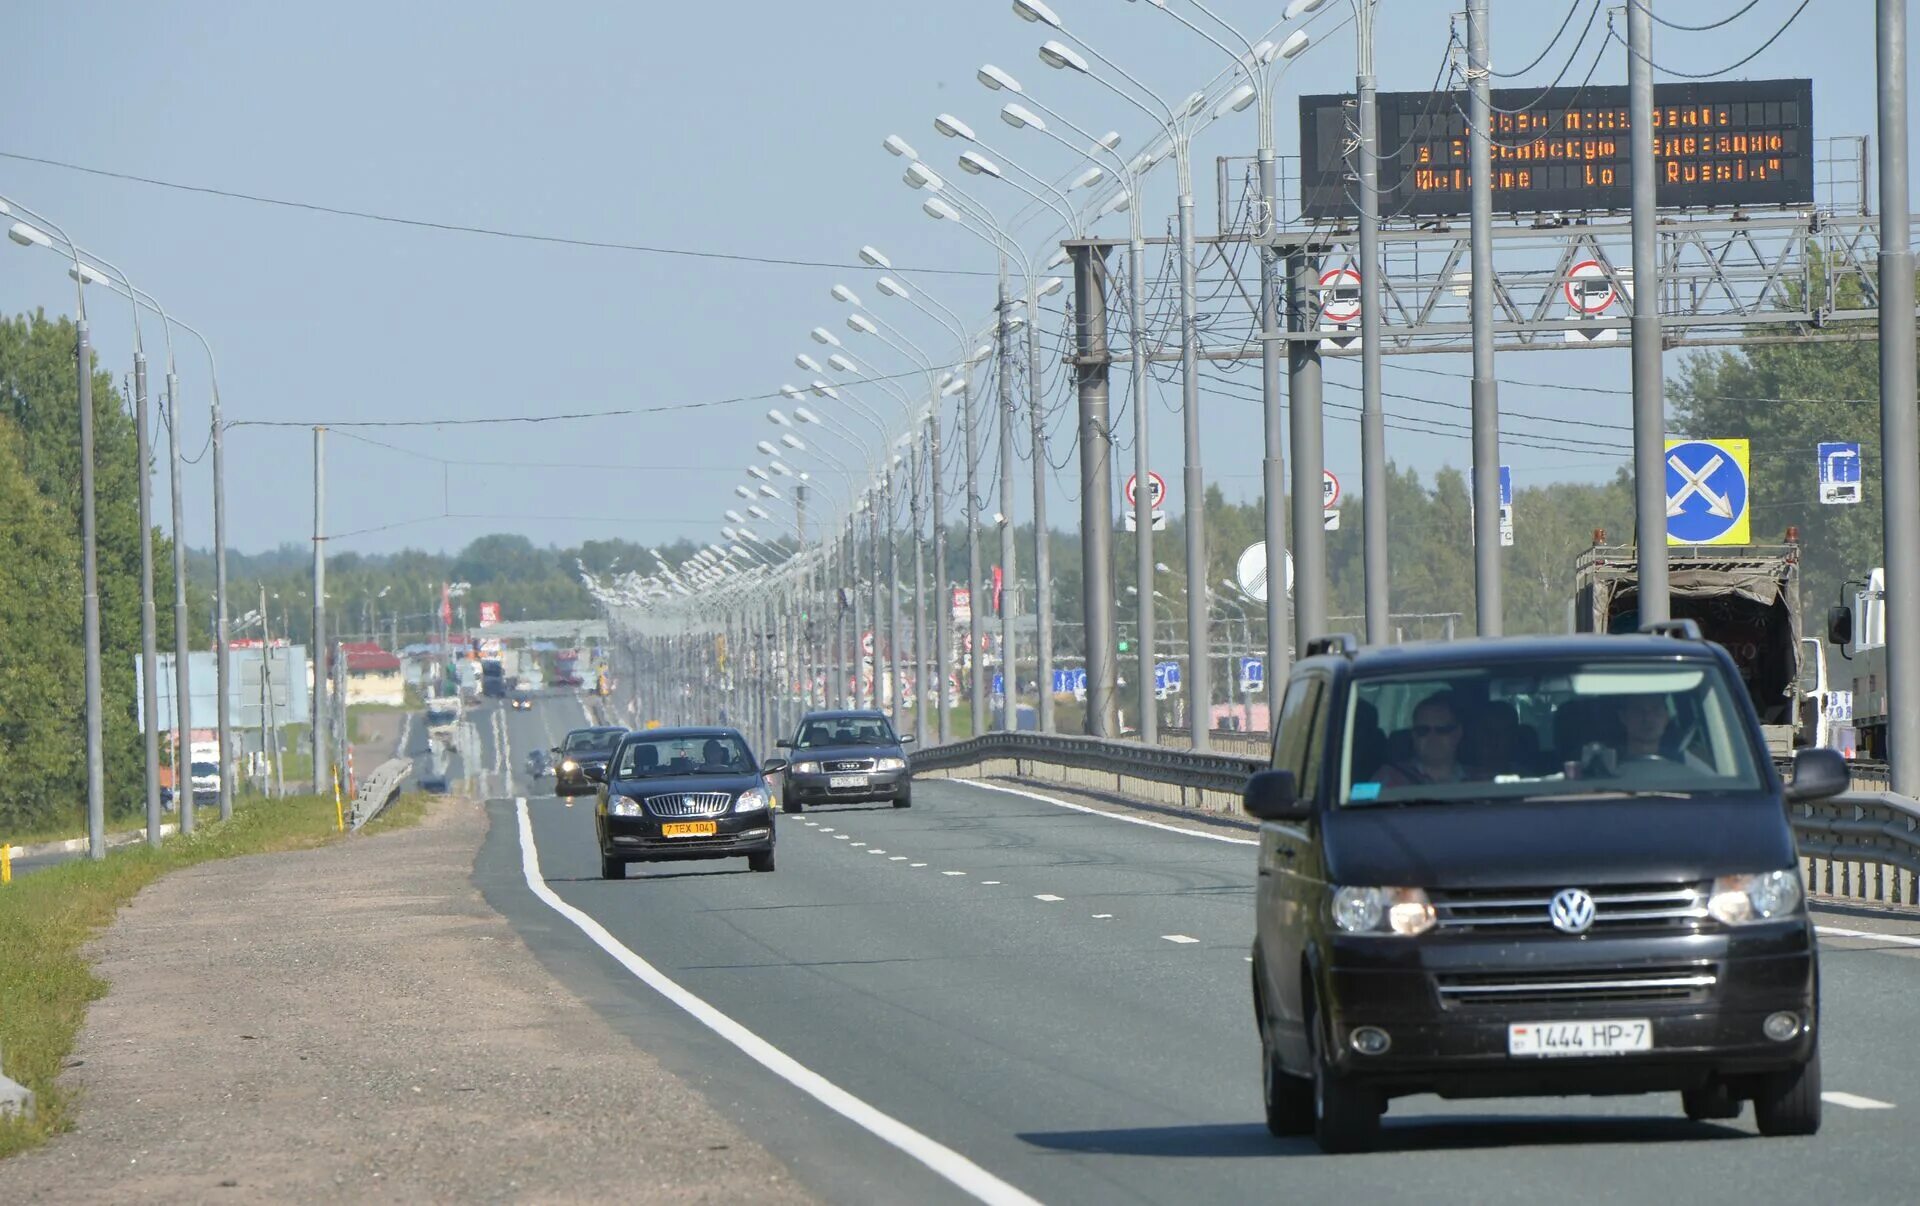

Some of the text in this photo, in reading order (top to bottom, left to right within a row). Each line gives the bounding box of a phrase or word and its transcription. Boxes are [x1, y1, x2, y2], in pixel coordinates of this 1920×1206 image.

[1585, 164, 1615, 185] to
[666, 823, 714, 834] 7 TEX 1041
[1535, 1023, 1646, 1048] 1444 HP-7
